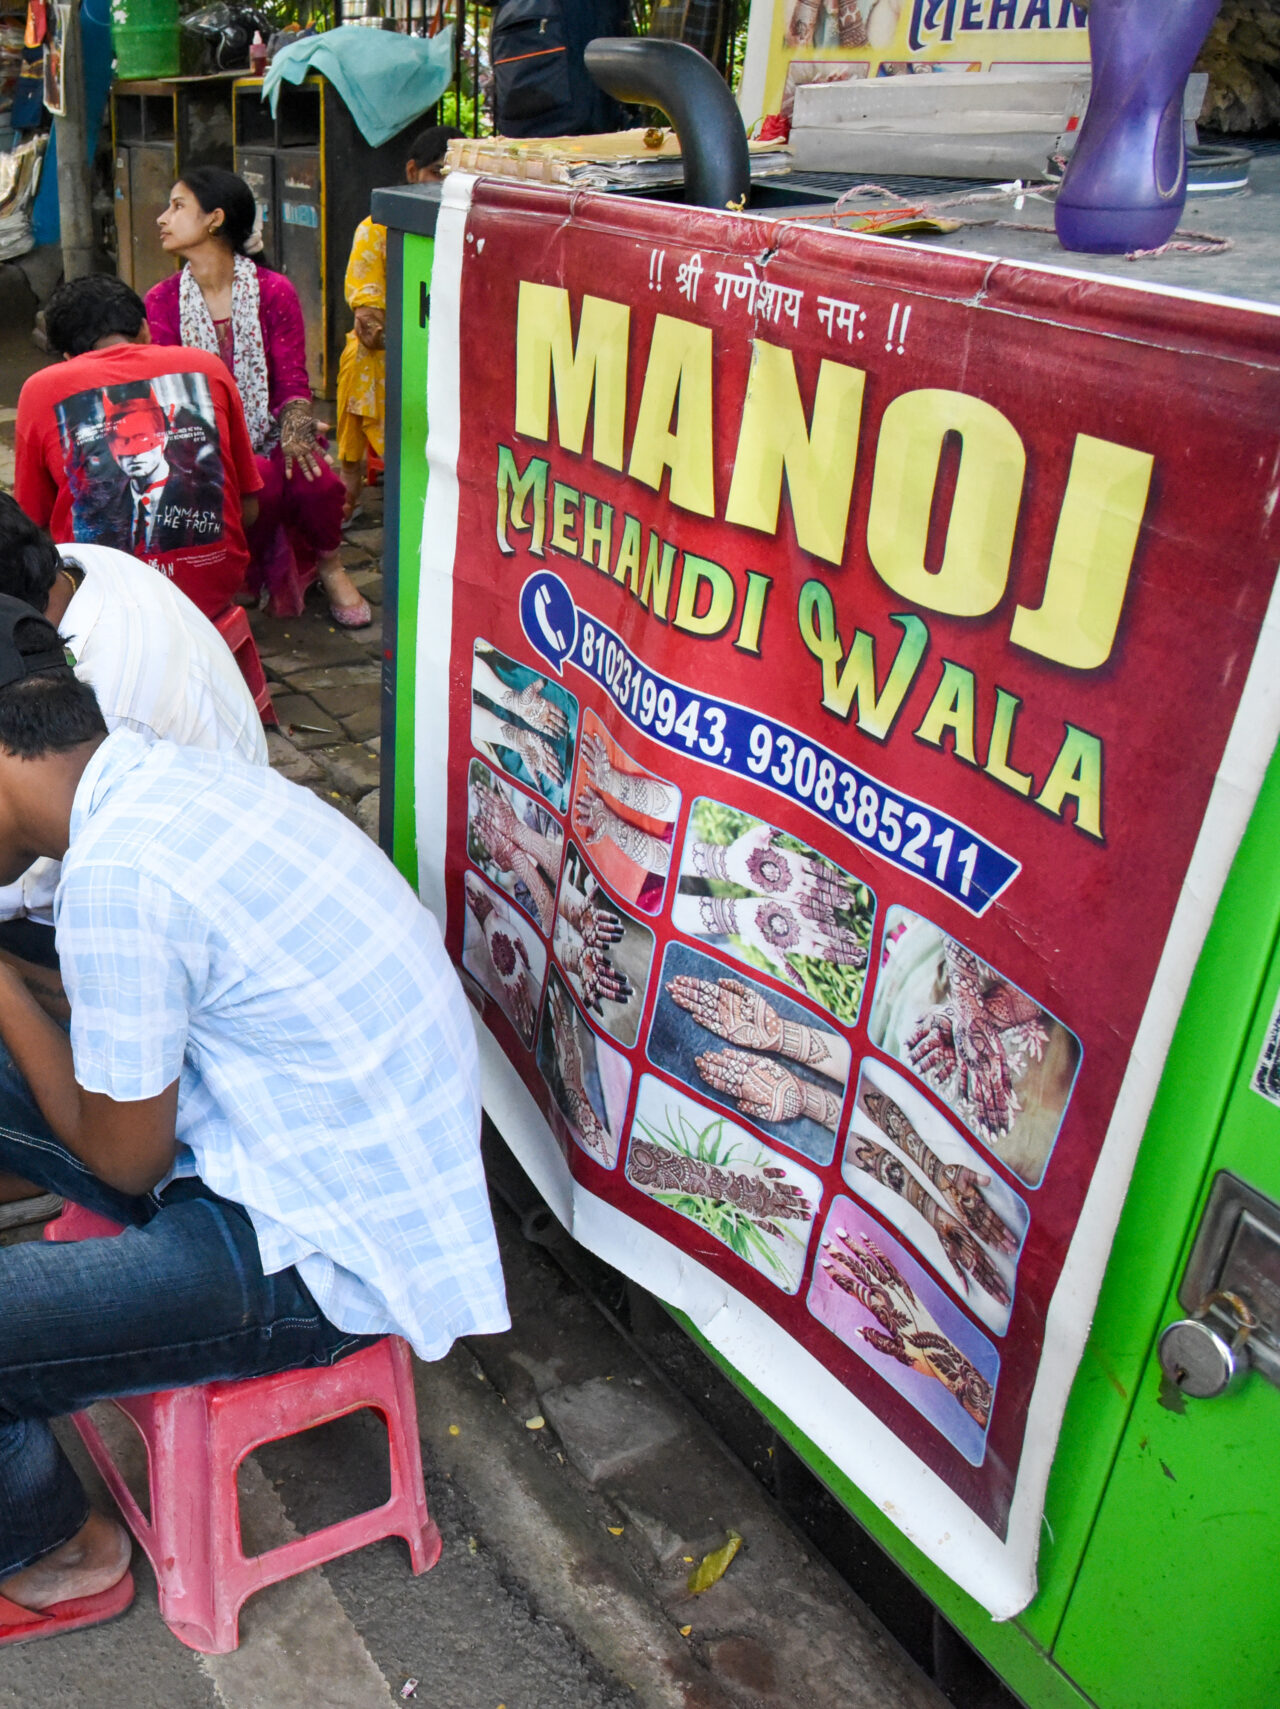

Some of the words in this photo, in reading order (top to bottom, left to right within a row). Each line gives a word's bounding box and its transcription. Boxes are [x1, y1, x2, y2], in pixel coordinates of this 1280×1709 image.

[675, 253, 704, 304] श्री
[713, 262, 805, 329] गणेशाय
[816, 295, 868, 345] नमः
[154, 513, 181, 529] THE
[185, 519, 221, 534] TRUTH
[164, 504, 217, 521] UNMASK
[514, 280, 1155, 670] MANOJ
[496, 442, 774, 656] MEHANDI
[797, 577, 1106, 842] WALA
[580, 622, 732, 765] 8102319943,
[746, 723, 979, 897] 9308385211
